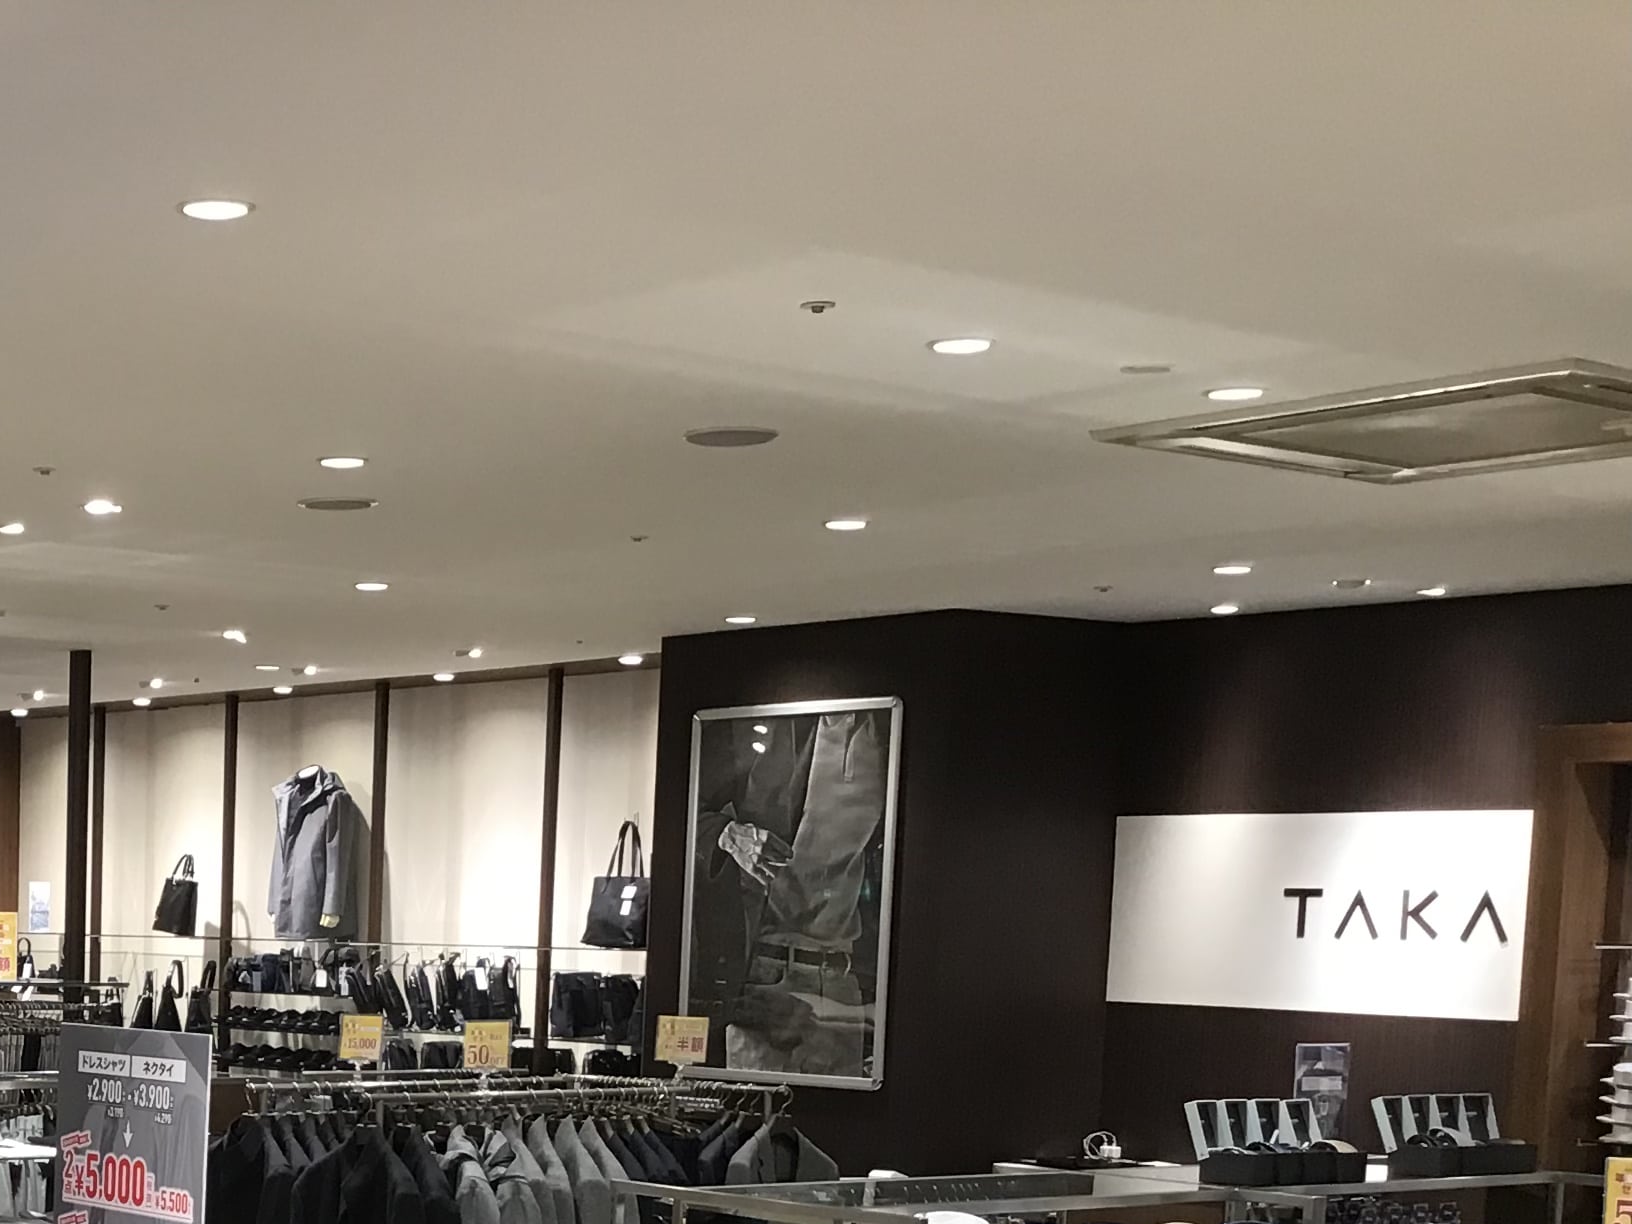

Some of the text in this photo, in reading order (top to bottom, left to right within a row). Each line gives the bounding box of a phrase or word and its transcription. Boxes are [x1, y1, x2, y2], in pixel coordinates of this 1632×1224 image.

[1284, 887, 1509, 944] TAKA
[82, 1055, 174, 1077] ドレスシャツ ネクタイ
